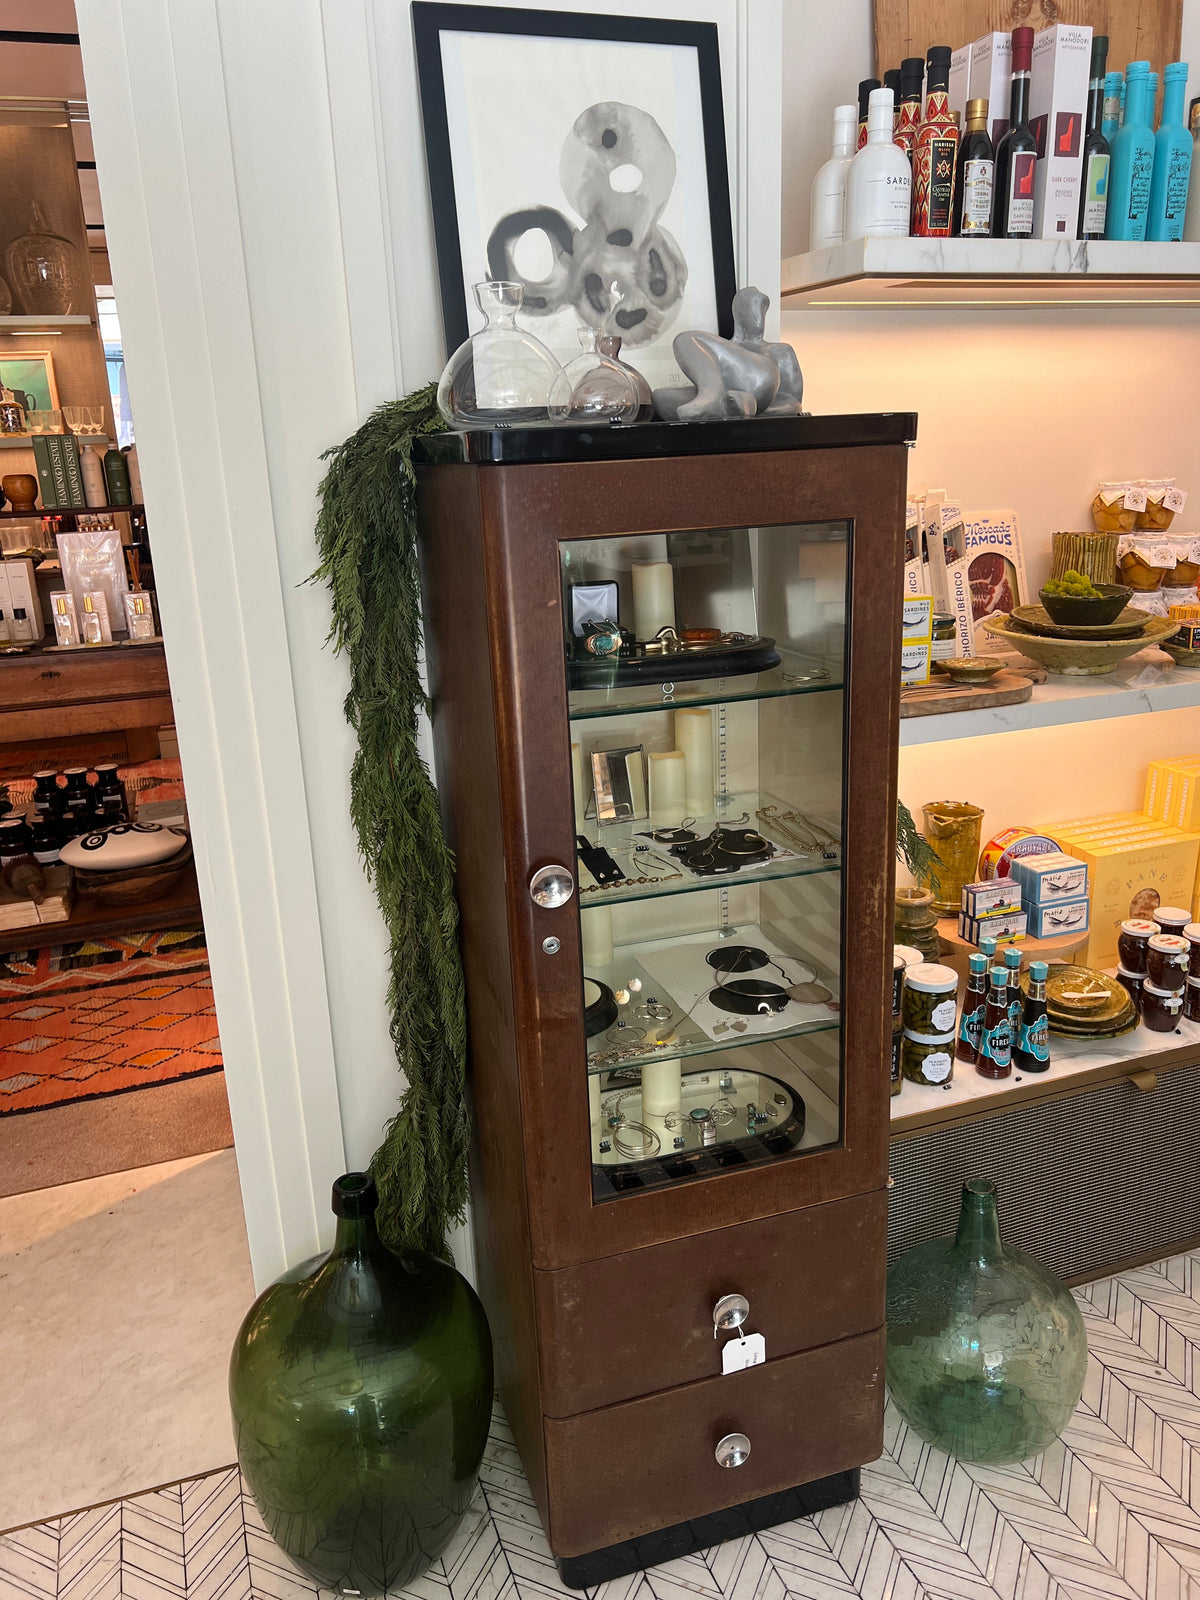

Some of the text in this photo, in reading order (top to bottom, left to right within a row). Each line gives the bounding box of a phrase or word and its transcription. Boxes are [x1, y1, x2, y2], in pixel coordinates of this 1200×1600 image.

[965, 521, 1011, 537] Mercado
[965, 533, 1012, 550] FAMOUS
[954, 571, 966, 612] IBÉRICO
